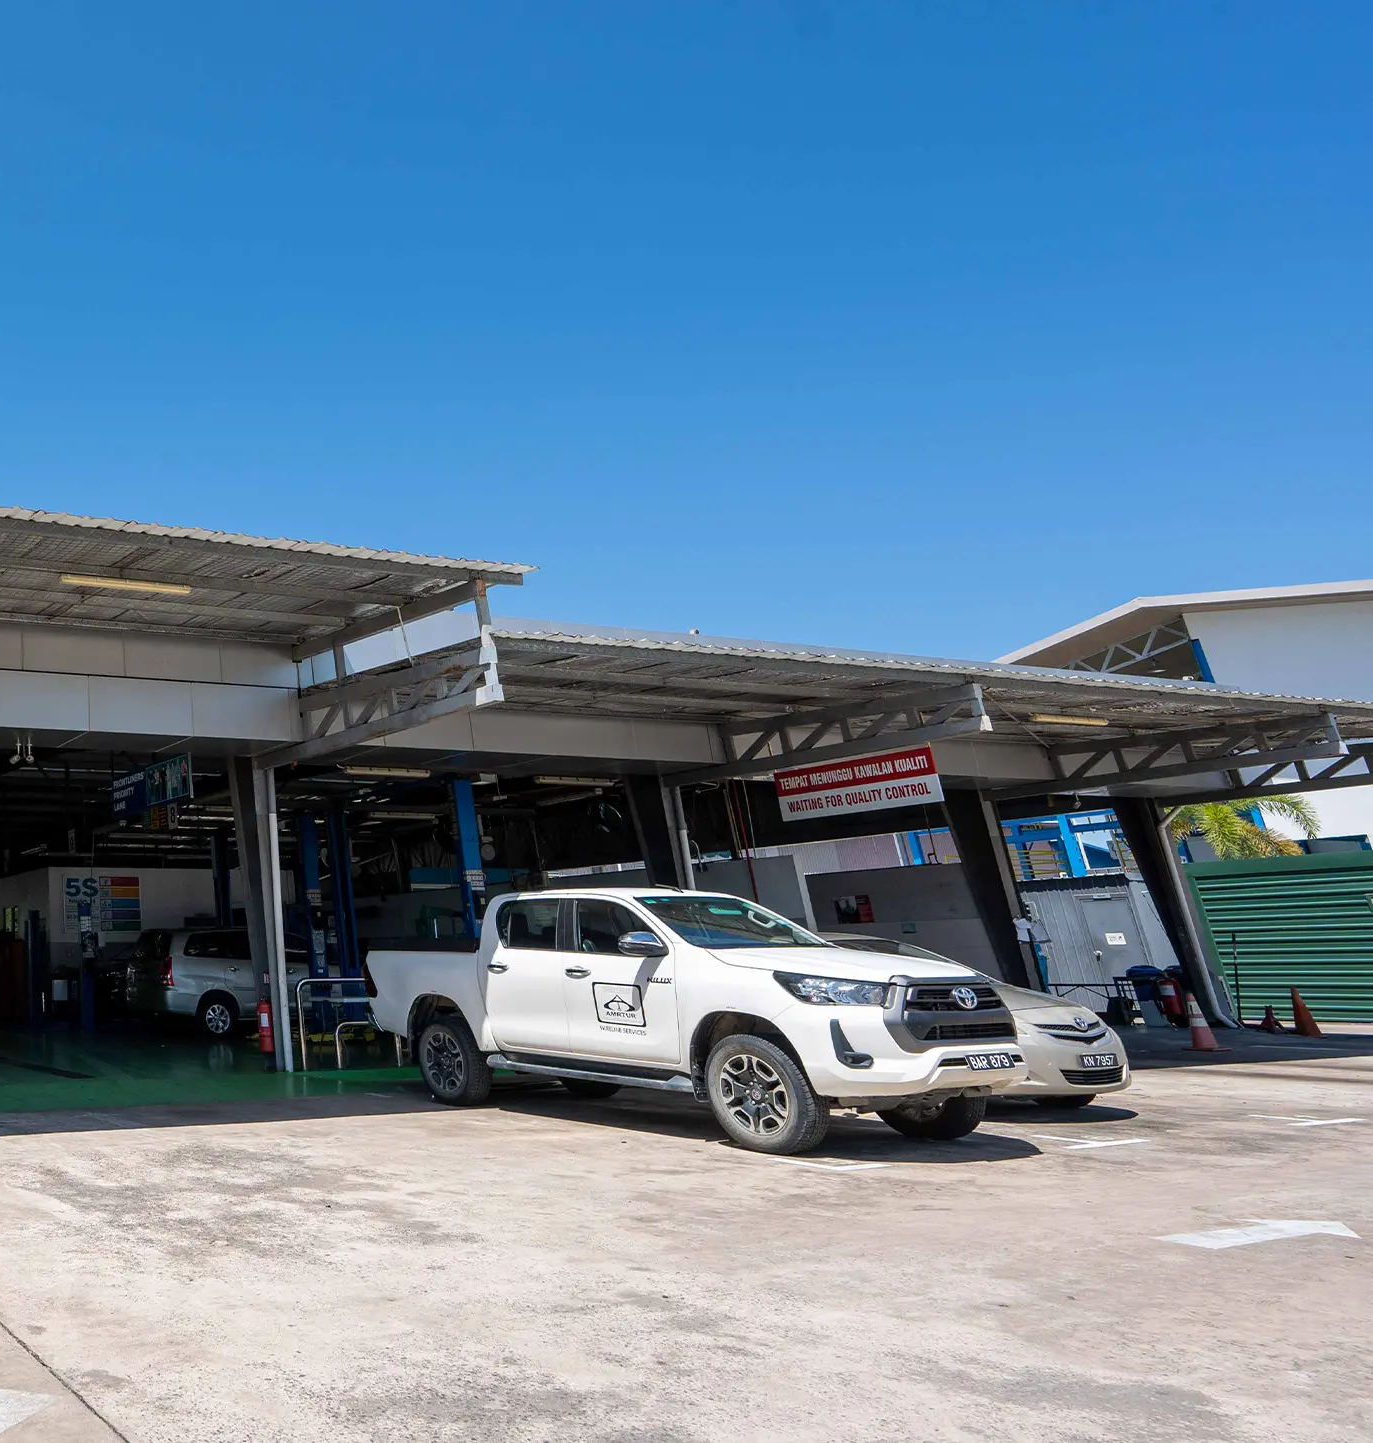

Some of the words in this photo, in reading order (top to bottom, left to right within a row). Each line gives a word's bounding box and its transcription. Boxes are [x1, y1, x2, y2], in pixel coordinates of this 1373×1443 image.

[113, 771, 144, 789] FRONTLINERS
[779, 774, 808, 791] TEMPAT
[809, 768, 853, 786] MENUNGGU
[854, 761, 893, 779] KAWALAN
[894, 755, 928, 773] KUALITI
[113, 786, 135, 800] PRIORITY
[787, 797, 824, 813] WAITING
[825, 793, 844, 808] FOR
[845, 788, 884, 806] QUALITY
[885, 782, 931, 800] CONTROL
[114, 801, 126, 812] LANE
[170, 806, 176, 824] 8
[66, 877, 99, 898] 5S
[647, 976, 673, 985] HILUX
[622, 1027, 647, 1036] SERVICES
[969, 1057, 989, 1069] BAR
[989, 1054, 1010, 1067] 879
[1083, 1056, 1095, 1067] KN
[1096, 1055, 1115, 1066] 7957
